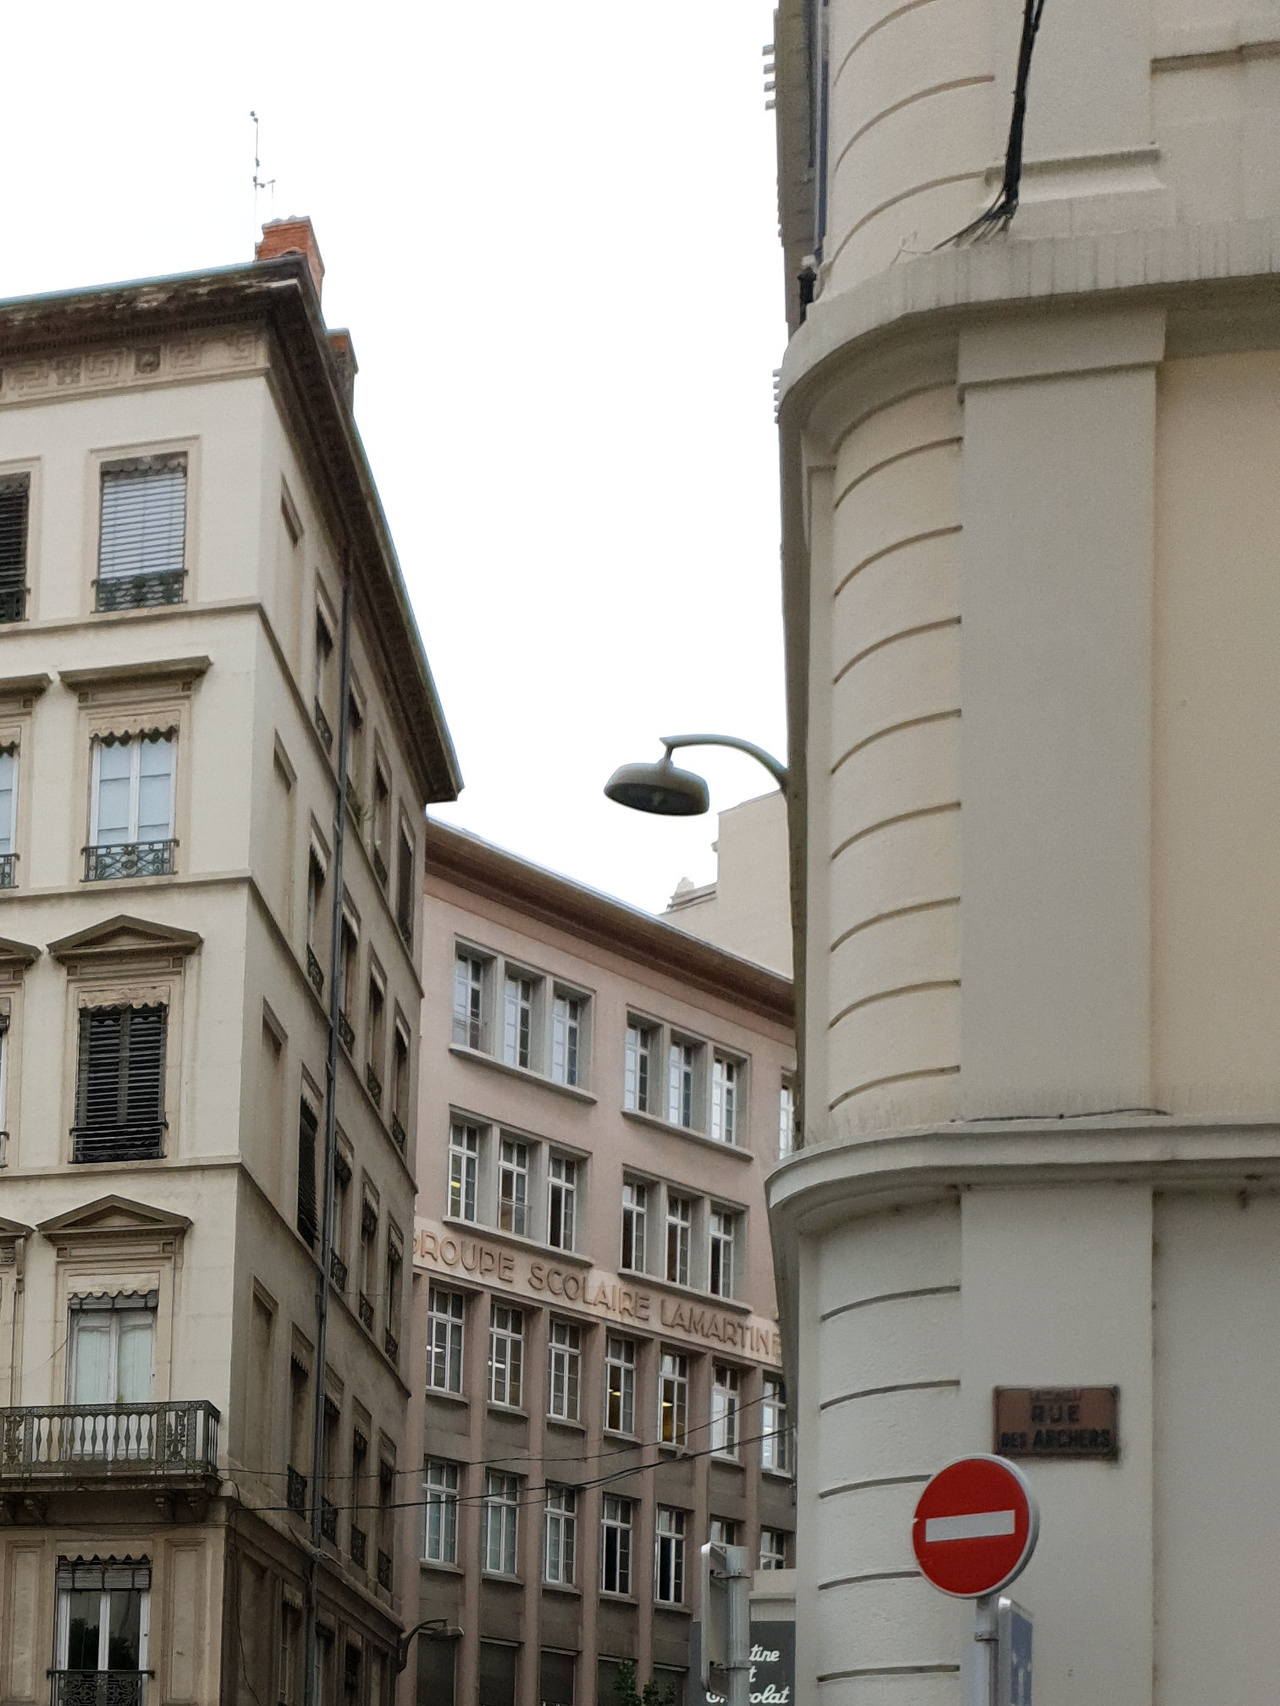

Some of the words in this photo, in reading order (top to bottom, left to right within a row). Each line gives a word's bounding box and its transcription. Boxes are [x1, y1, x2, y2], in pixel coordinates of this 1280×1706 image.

[528, 1261, 650, 1321] SCOLAIRE
[1030, 1404, 1080, 1422] RUE
[1032, 1428, 1110, 1449] ARCHERS
